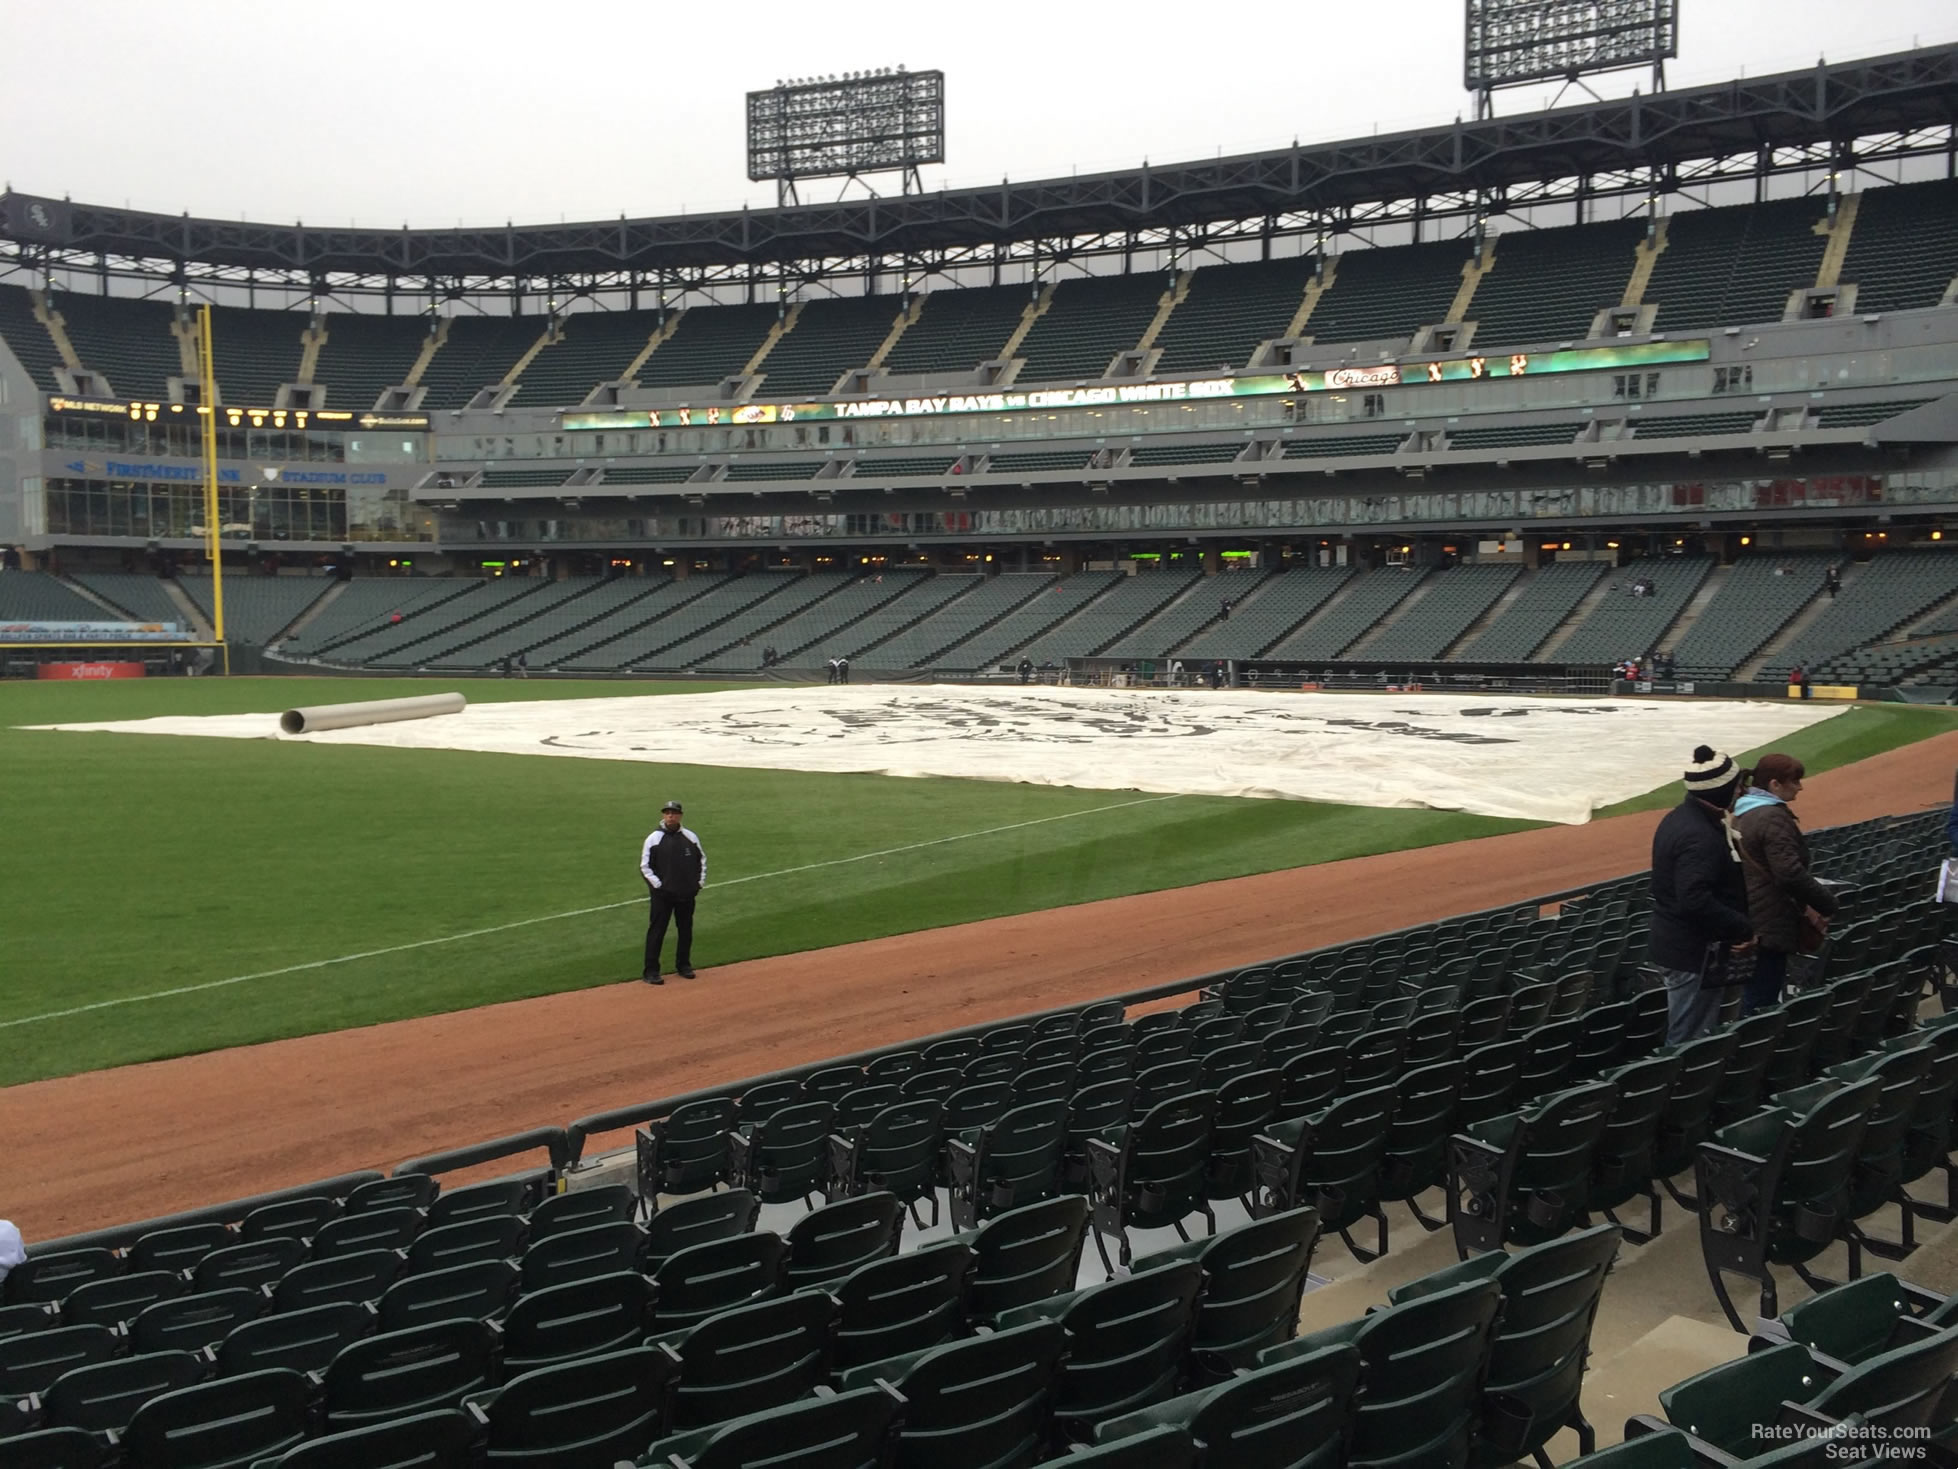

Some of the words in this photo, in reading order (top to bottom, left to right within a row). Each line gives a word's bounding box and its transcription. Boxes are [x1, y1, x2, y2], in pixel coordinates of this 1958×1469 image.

[1333, 368, 1399, 386] Chicago
[834, 400, 904, 417] TAMPA
[905, 398, 947, 415] BAY
[948, 395, 1004, 413] RAYS
[1028, 388, 1116, 407] CHICAGO
[1118, 383, 1186, 401] WHITE
[1188, 378, 1235, 396] SOX
[282, 472, 347, 484] STADIUM
[350, 473, 387, 485] CLUB
[71, 664, 114, 679] xfinity
